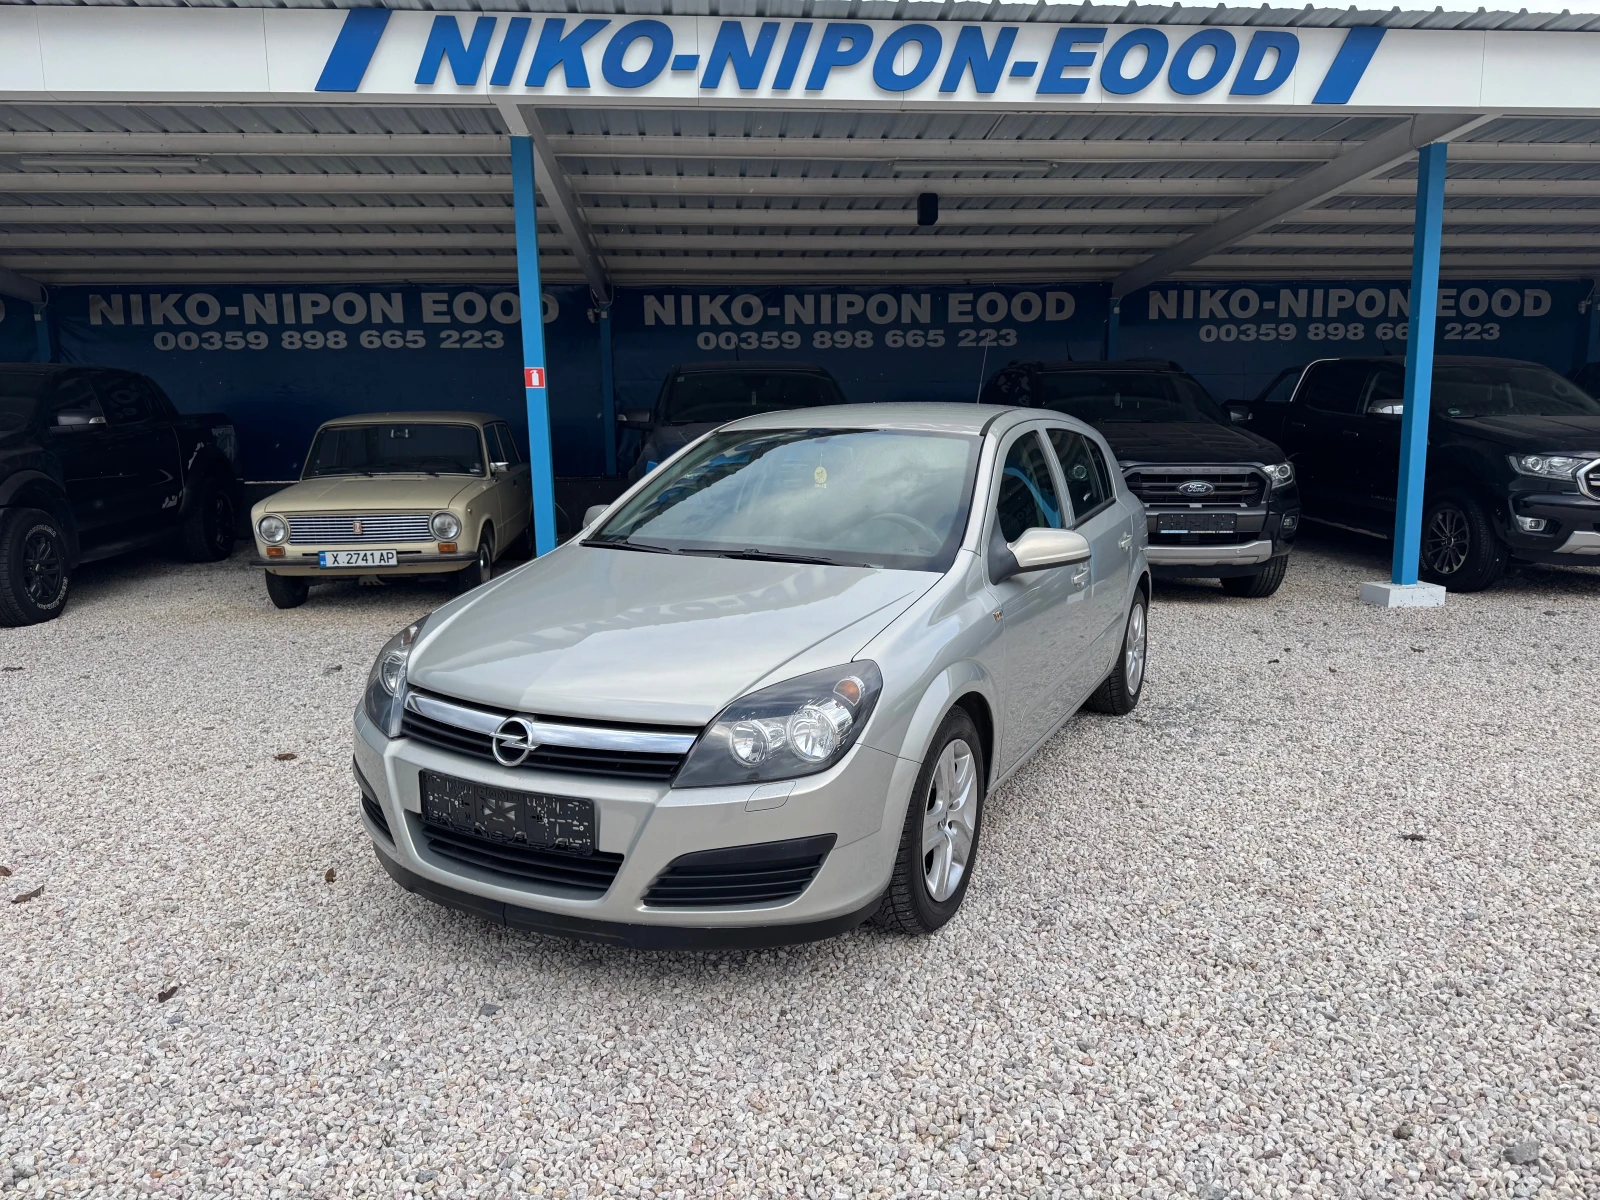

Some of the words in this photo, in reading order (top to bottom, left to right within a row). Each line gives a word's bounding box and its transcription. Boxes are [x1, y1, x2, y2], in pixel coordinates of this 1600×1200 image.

[414, 15, 1299, 95] NIKO-NIPON-EOOD
[89, 292, 404, 325] NIKO-NIPON
[421, 291, 560, 325] EOOD
[643, 293, 931, 326] NIKO-NIPON
[948, 291, 1076, 323] EOOD
[1148, 287, 1412, 319] NIKO-NIPON
[1436, 287, 1552, 318] EOOD
[153, 330, 269, 351] 00359
[281, 330, 348, 350] 898
[359, 329, 427, 350] 665
[439, 329, 505, 349] 223
[696, 330, 802, 351] 00359
[812, 330, 874, 349] 898
[884, 329, 946, 348] 665
[957, 328, 1018, 347] 223
[1199, 322, 1297, 343] 00359
[1307, 322, 1365, 342] 898
[1375, 322, 1409, 341] 66
[1443, 321, 1501, 341] 223
[1187, 483, 1207, 493] Ford
[346, 552, 375, 564] 2741
[379, 551, 395, 564] AP
